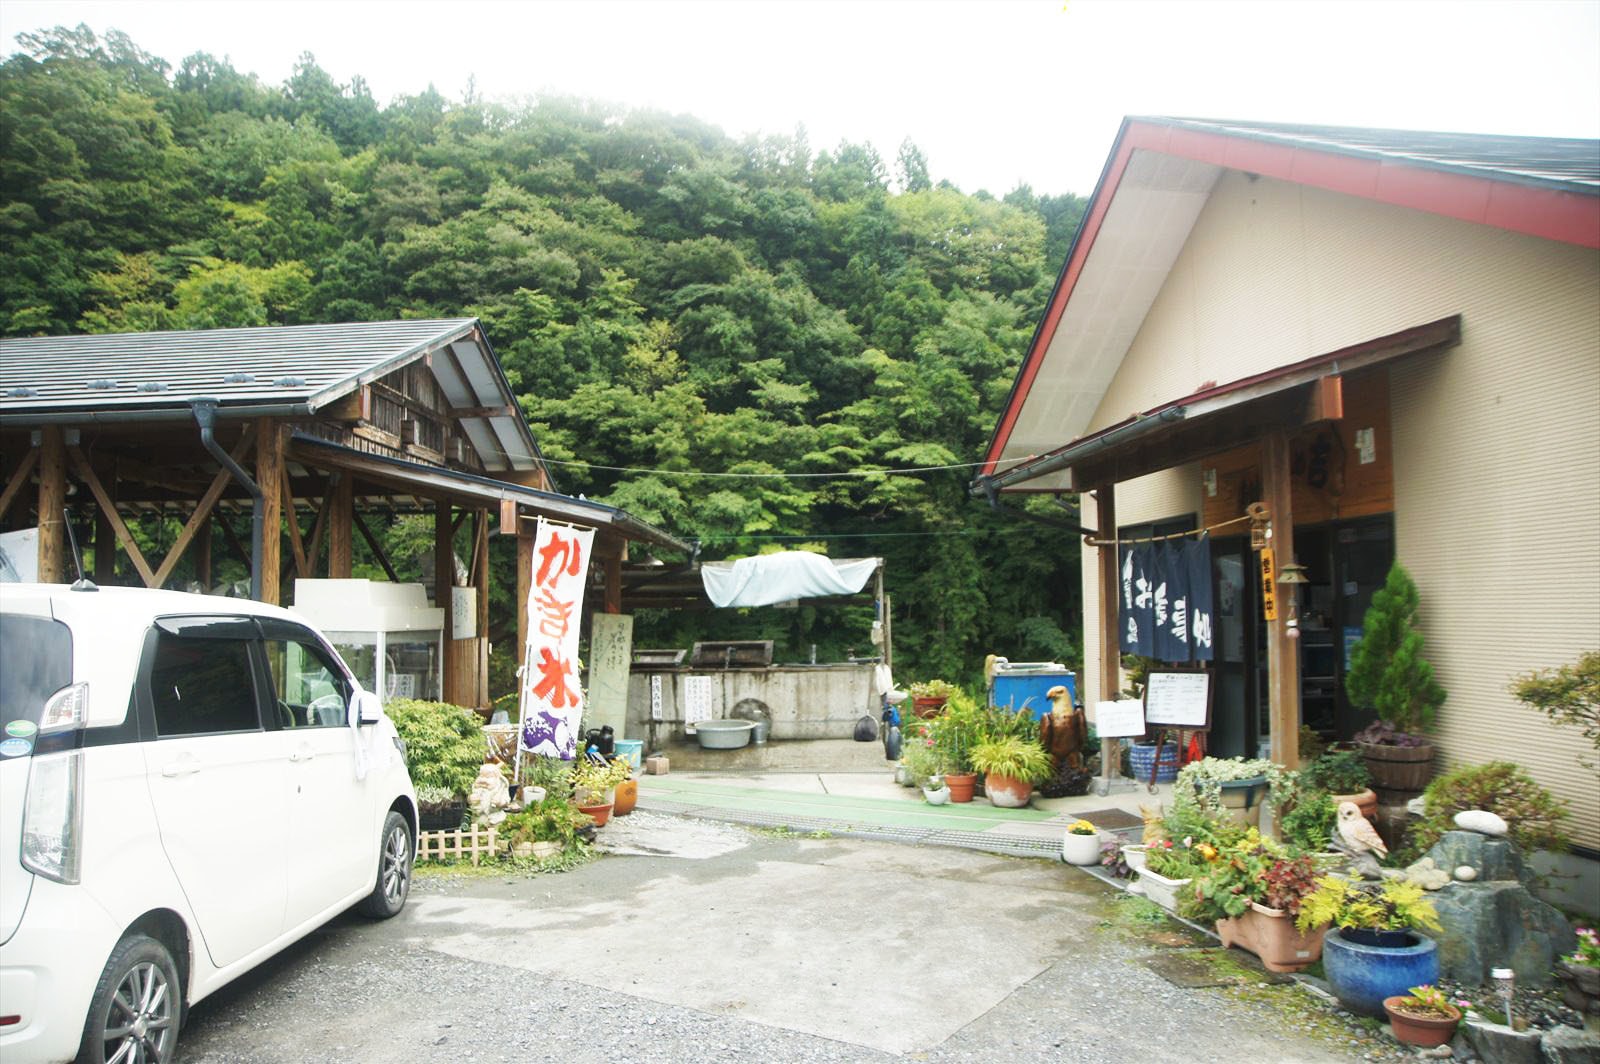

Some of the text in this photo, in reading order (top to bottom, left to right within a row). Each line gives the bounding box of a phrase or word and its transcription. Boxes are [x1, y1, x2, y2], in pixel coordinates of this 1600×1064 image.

[532, 531, 582, 710] かき氷
[1135, 568, 1212, 648] お食事処
